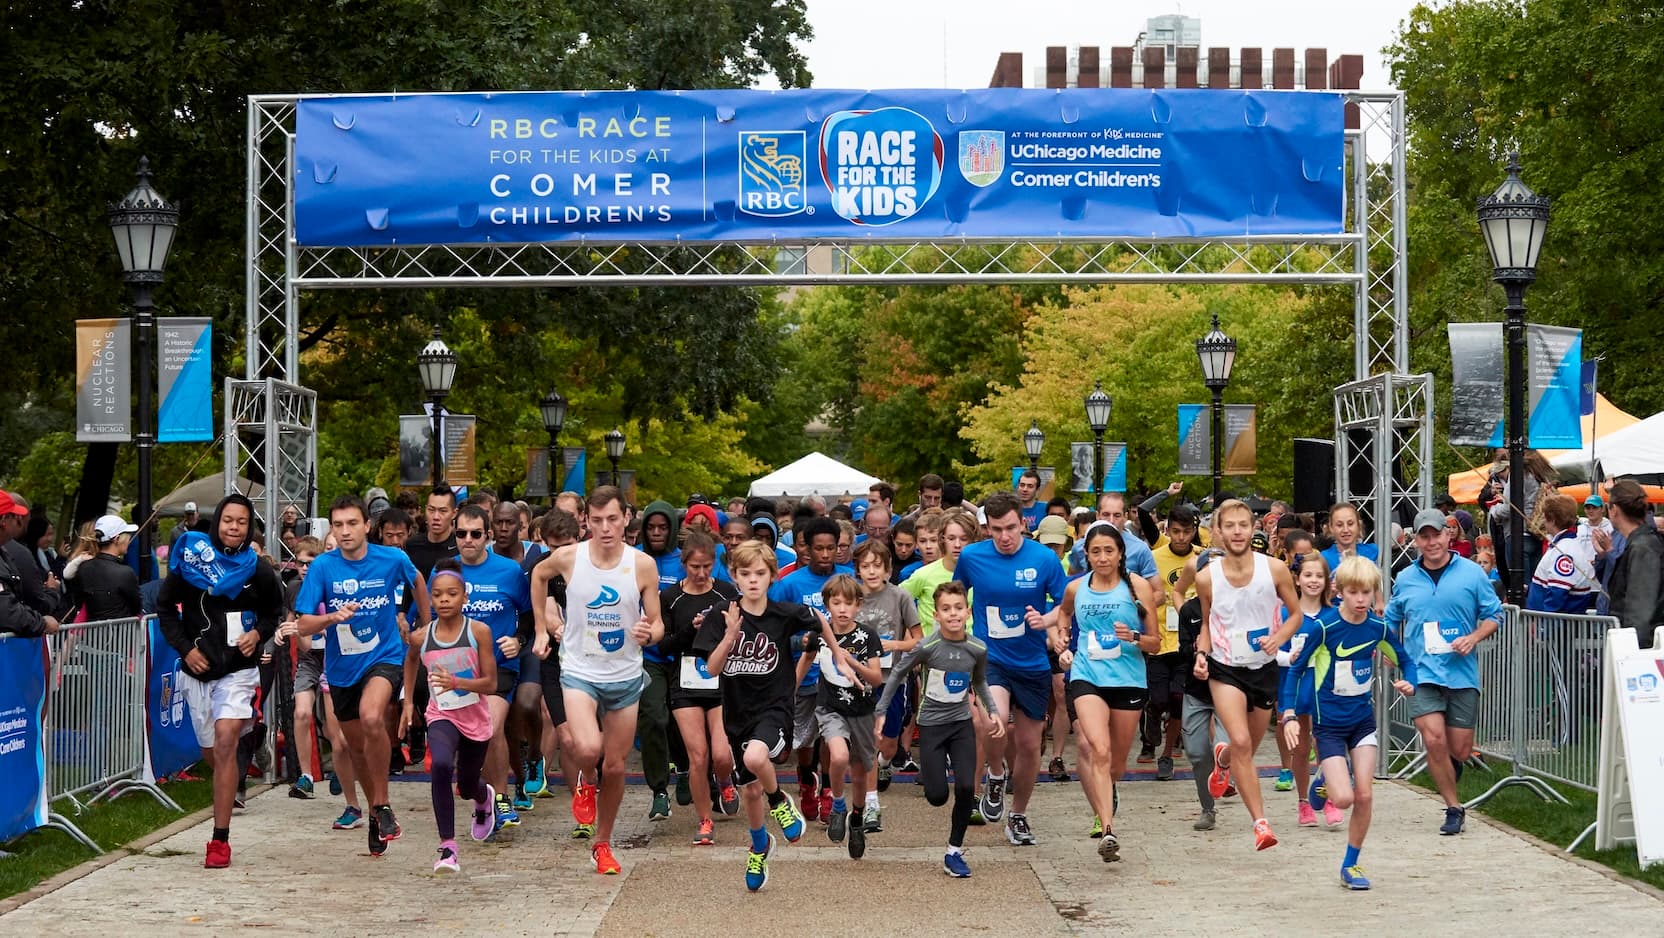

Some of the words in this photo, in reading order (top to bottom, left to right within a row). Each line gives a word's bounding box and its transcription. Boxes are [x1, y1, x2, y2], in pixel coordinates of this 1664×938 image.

[489, 118, 558, 139] RBC
[579, 117, 672, 138] RACE
[490, 150, 532, 164] FOR
[540, 149, 580, 164] THE
[590, 148, 637, 164] KIDS
[646, 148, 671, 163] AT
[837, 130, 916, 166] RACE
[1011, 144, 1088, 161] UChicago
[1090, 144, 1161, 160] Medicine
[490, 173, 672, 197] COMER
[838, 167, 876, 185] FOR
[881, 167, 916, 184] THE
[1010, 171, 1071, 187] Comer
[1074, 170, 1161, 188] Children's
[747, 191, 800, 210] RBC
[837, 186, 918, 216] KIDS
[490, 205, 672, 225] CHILDREN'S
[92, 338, 102, 407] NUCLEAR
[105, 331, 115, 414] REACTIONS
[587, 612, 621, 620] PACERS
[357, 626, 372, 637] 558
